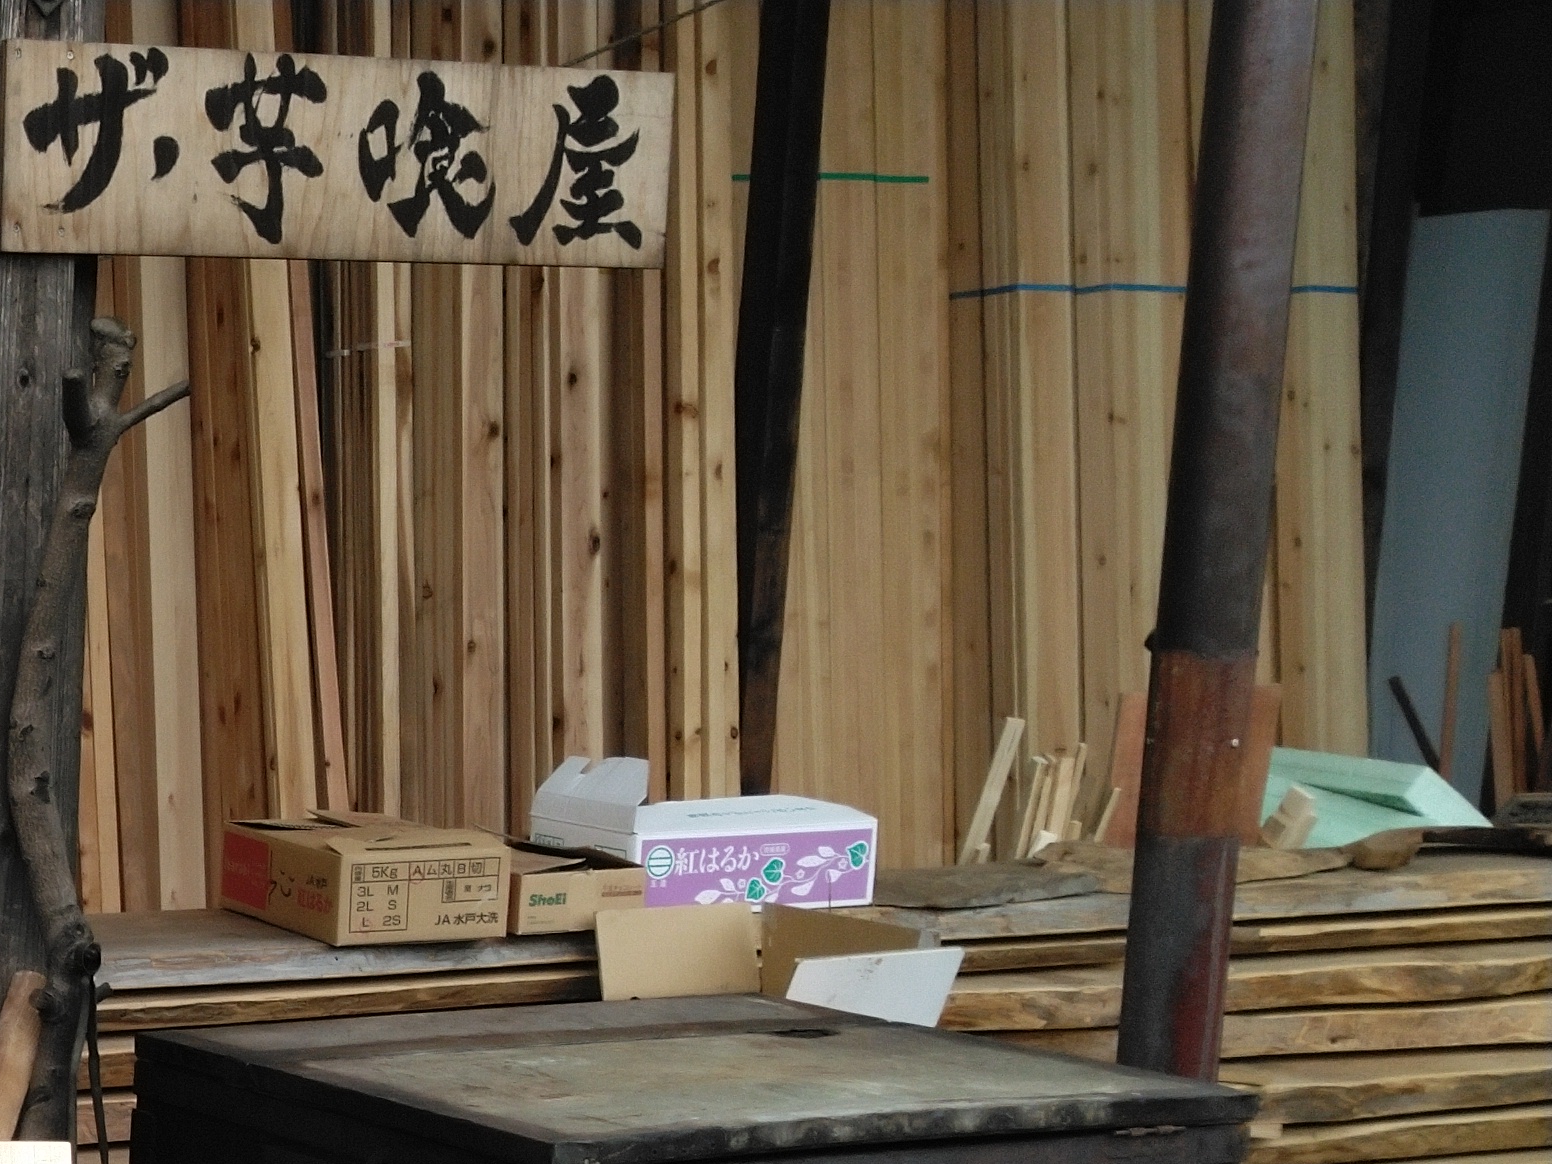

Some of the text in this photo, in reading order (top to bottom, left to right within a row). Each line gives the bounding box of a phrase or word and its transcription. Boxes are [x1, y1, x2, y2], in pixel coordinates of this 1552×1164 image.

[674, 845, 761, 877] 紅はるか
[357, 884, 399, 897] 3L M
[356, 900, 397, 912] 2L S
[362, 915, 402, 928] L 2S
